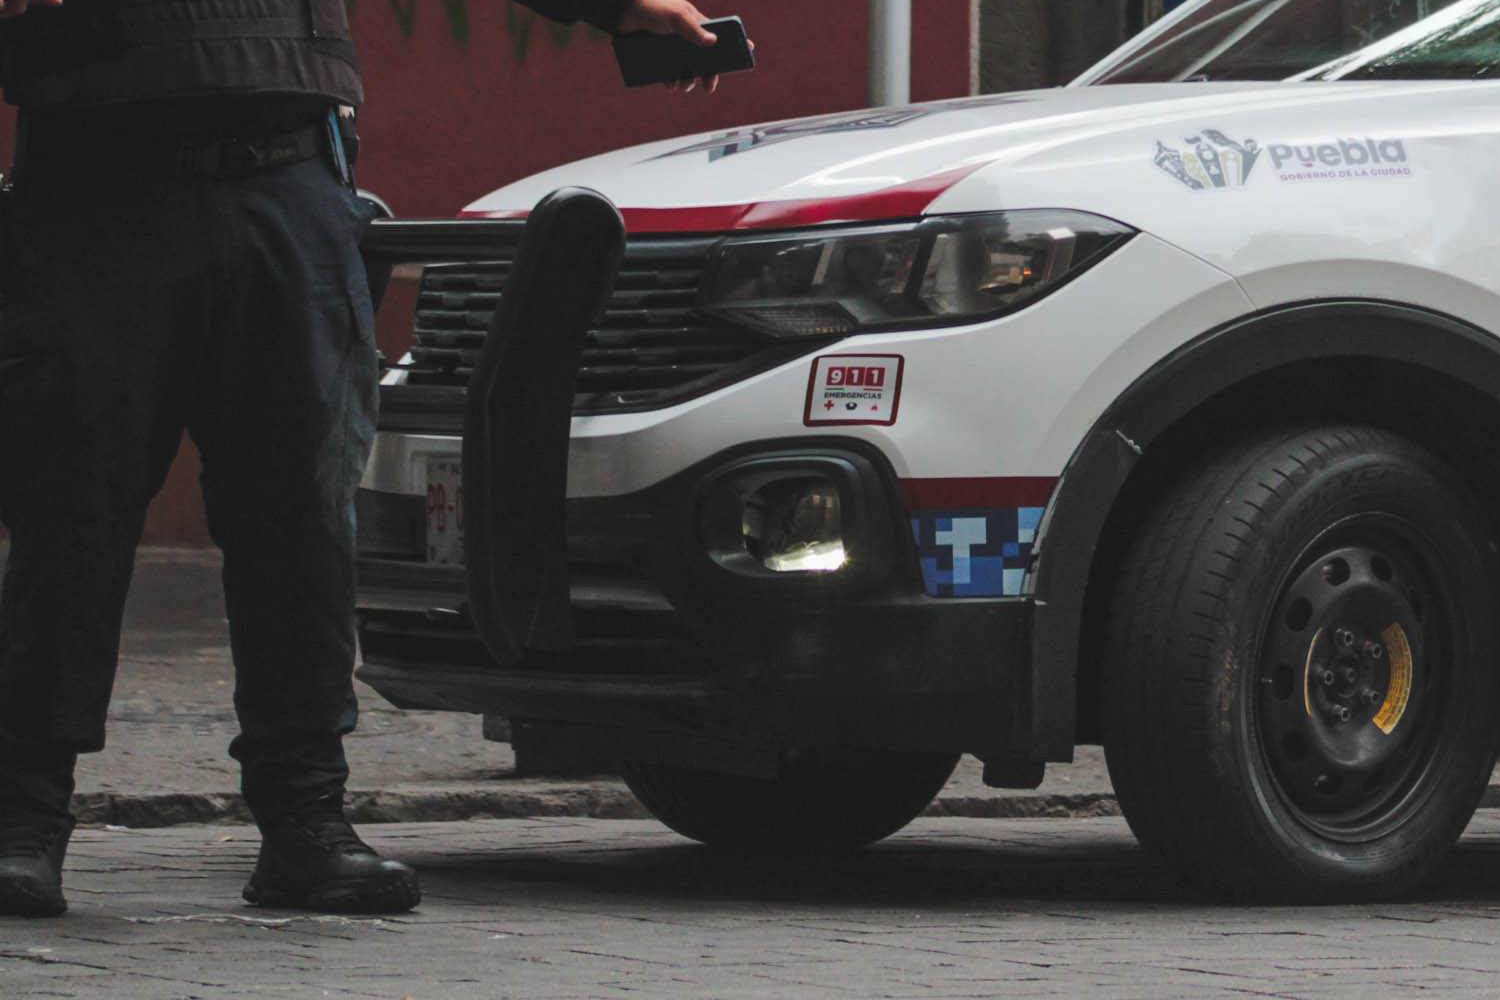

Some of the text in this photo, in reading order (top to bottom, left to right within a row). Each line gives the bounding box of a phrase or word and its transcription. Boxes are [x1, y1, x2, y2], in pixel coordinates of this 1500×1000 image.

[1267, 137, 1406, 170] Puebla
[1280, 167, 1411, 181] GOBIERNO DE LA CIUDAD
[830, 368, 880, 384] 911
[824, 391, 882, 399] EMERGENCIAS
